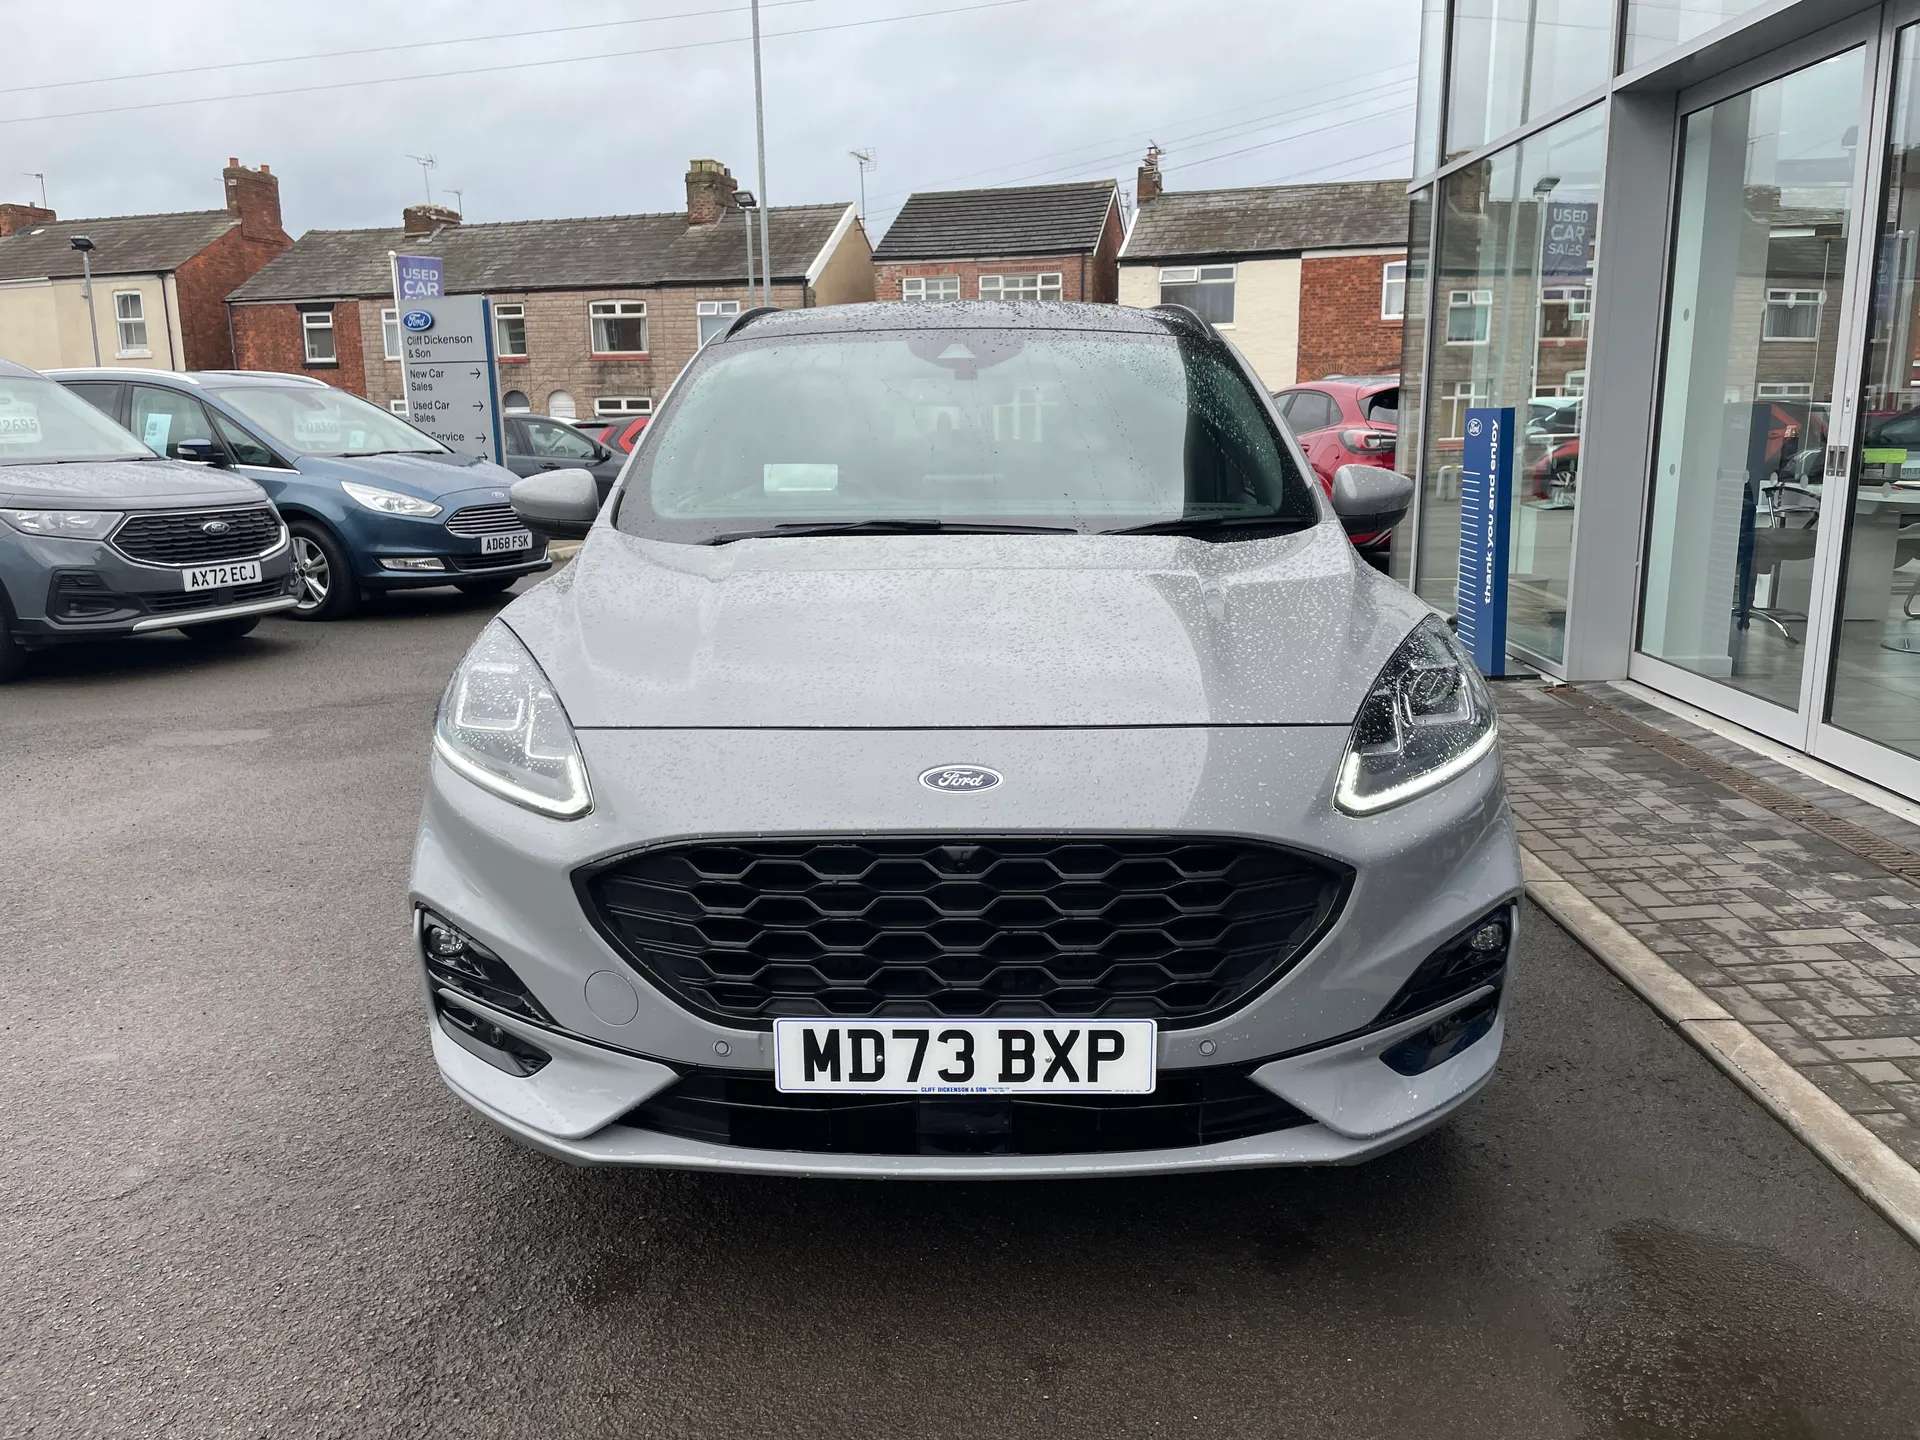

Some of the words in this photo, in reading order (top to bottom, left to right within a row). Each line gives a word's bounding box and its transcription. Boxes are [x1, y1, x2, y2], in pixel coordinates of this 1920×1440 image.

[1553, 208, 1588, 222] USED
[1551, 224, 1585, 241] CAR
[402, 267, 439, 280] USED
[403, 281, 439, 296] CAR
[407, 313, 425, 327] Ford
[406, 335, 423, 345] Cliff
[424, 335, 473, 344] Dickenson
[408, 350, 413, 359] &
[415, 349, 431, 358] Son
[409, 370, 427, 379] New
[428, 368, 445, 378] Car
[411, 382, 433, 391] Sales
[412, 400, 433, 410] Used
[434, 400, 450, 410] Car
[414, 413, 436, 422] Sales
[0, 418, 37, 433] 2695
[1489, 419, 1500, 471] enjoy
[1488, 474, 1497, 511] and
[1486, 514, 1495, 549] you
[486, 537, 511, 552] AD68
[512, 534, 529, 549] FSK
[191, 568, 228, 587] AX72
[230, 565, 256, 582] ECJ
[1484, 551, 1494, 605] thank
[938, 770, 985, 786] Ford
[802, 1029, 975, 1082] MD73
[998, 1029, 1126, 1083] BXP
